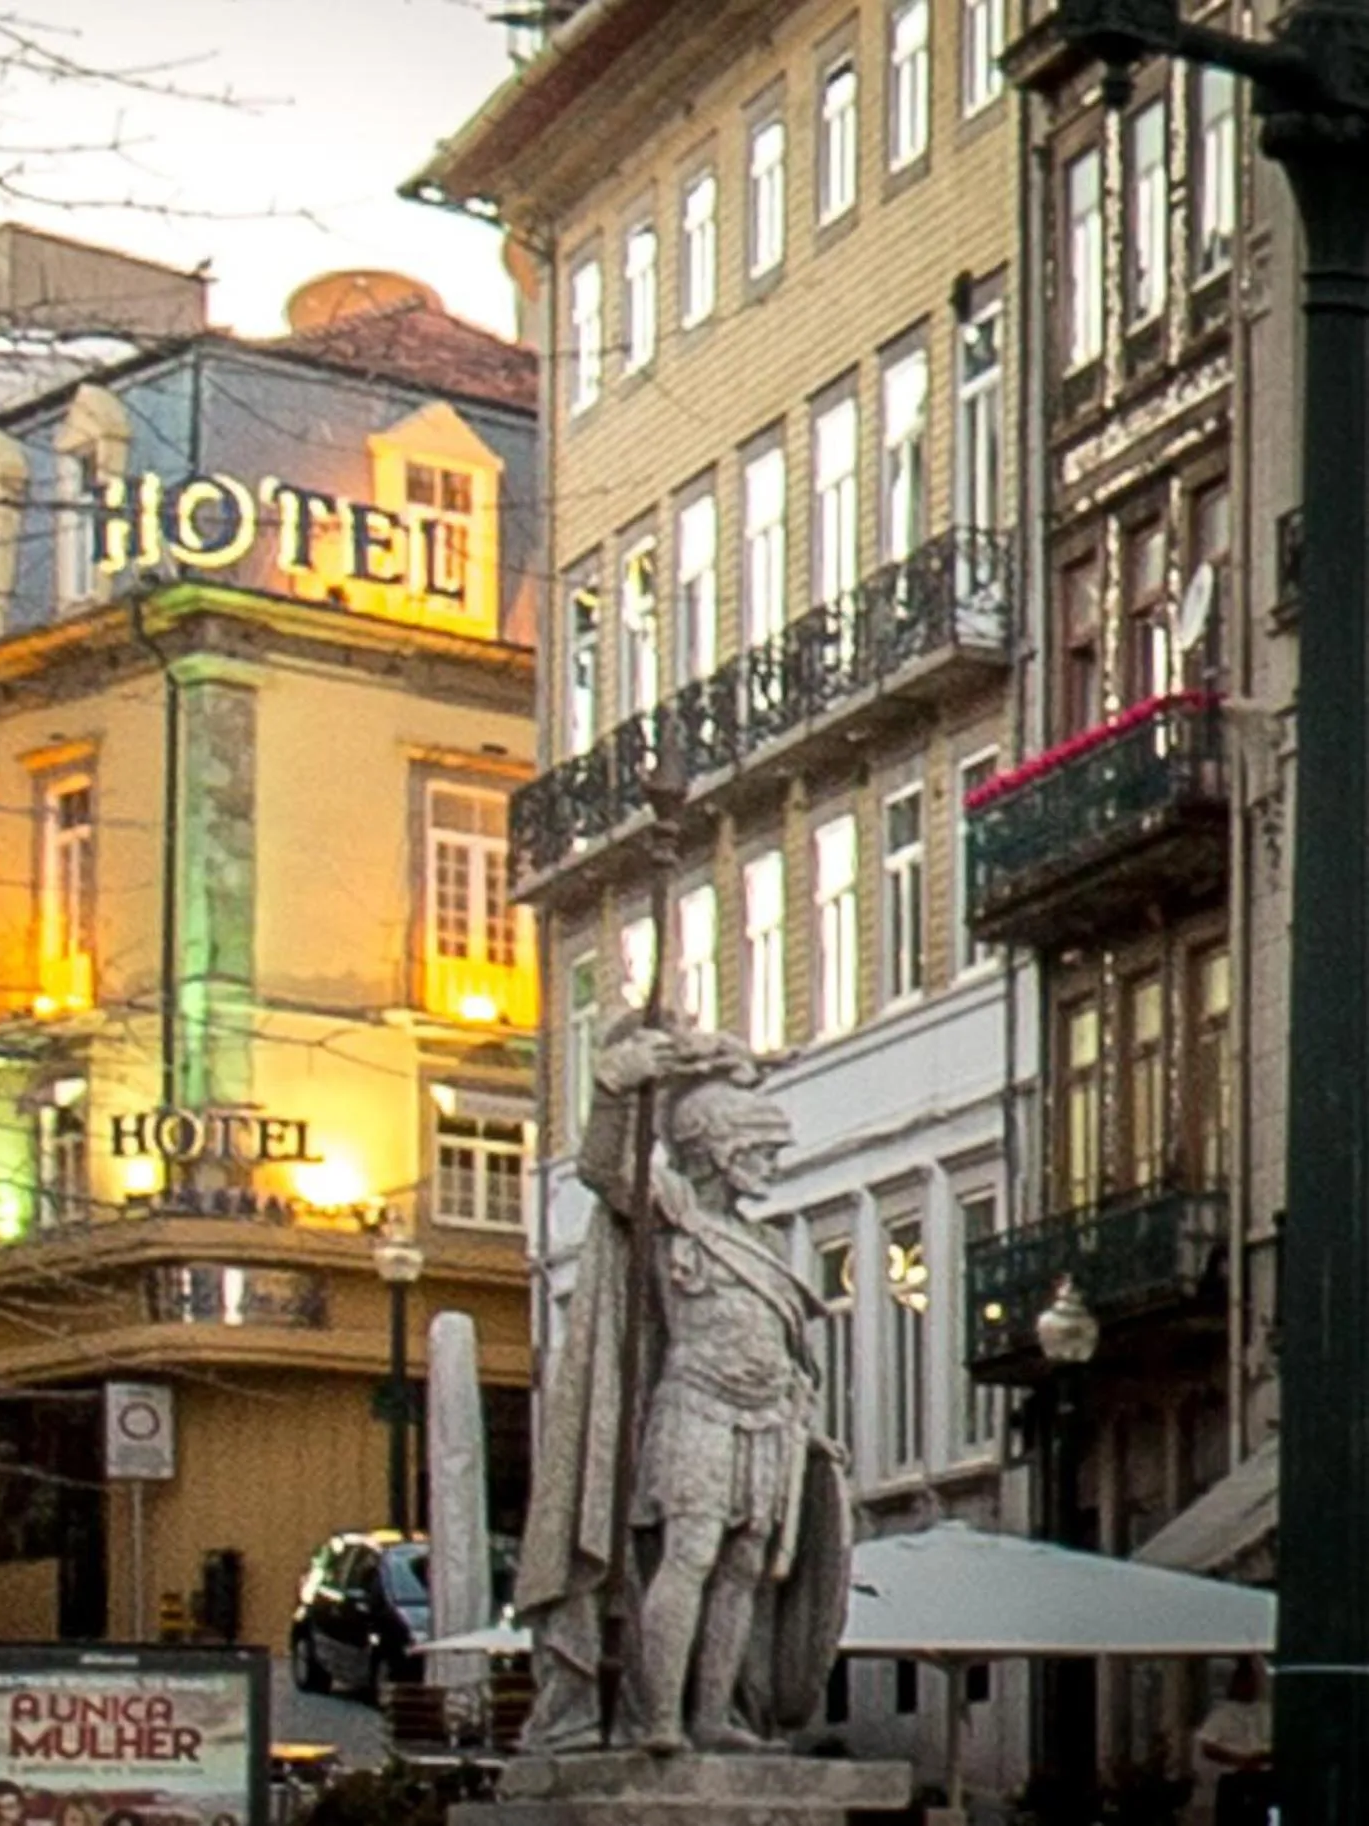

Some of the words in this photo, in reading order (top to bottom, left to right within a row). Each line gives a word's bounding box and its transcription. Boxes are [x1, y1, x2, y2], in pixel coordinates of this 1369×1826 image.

[90, 471, 469, 603] HOTEL
[110, 1109, 324, 1163] HOTEL
[10, 1693, 39, 1722] A
[8, 1724, 204, 1762] MULHER
